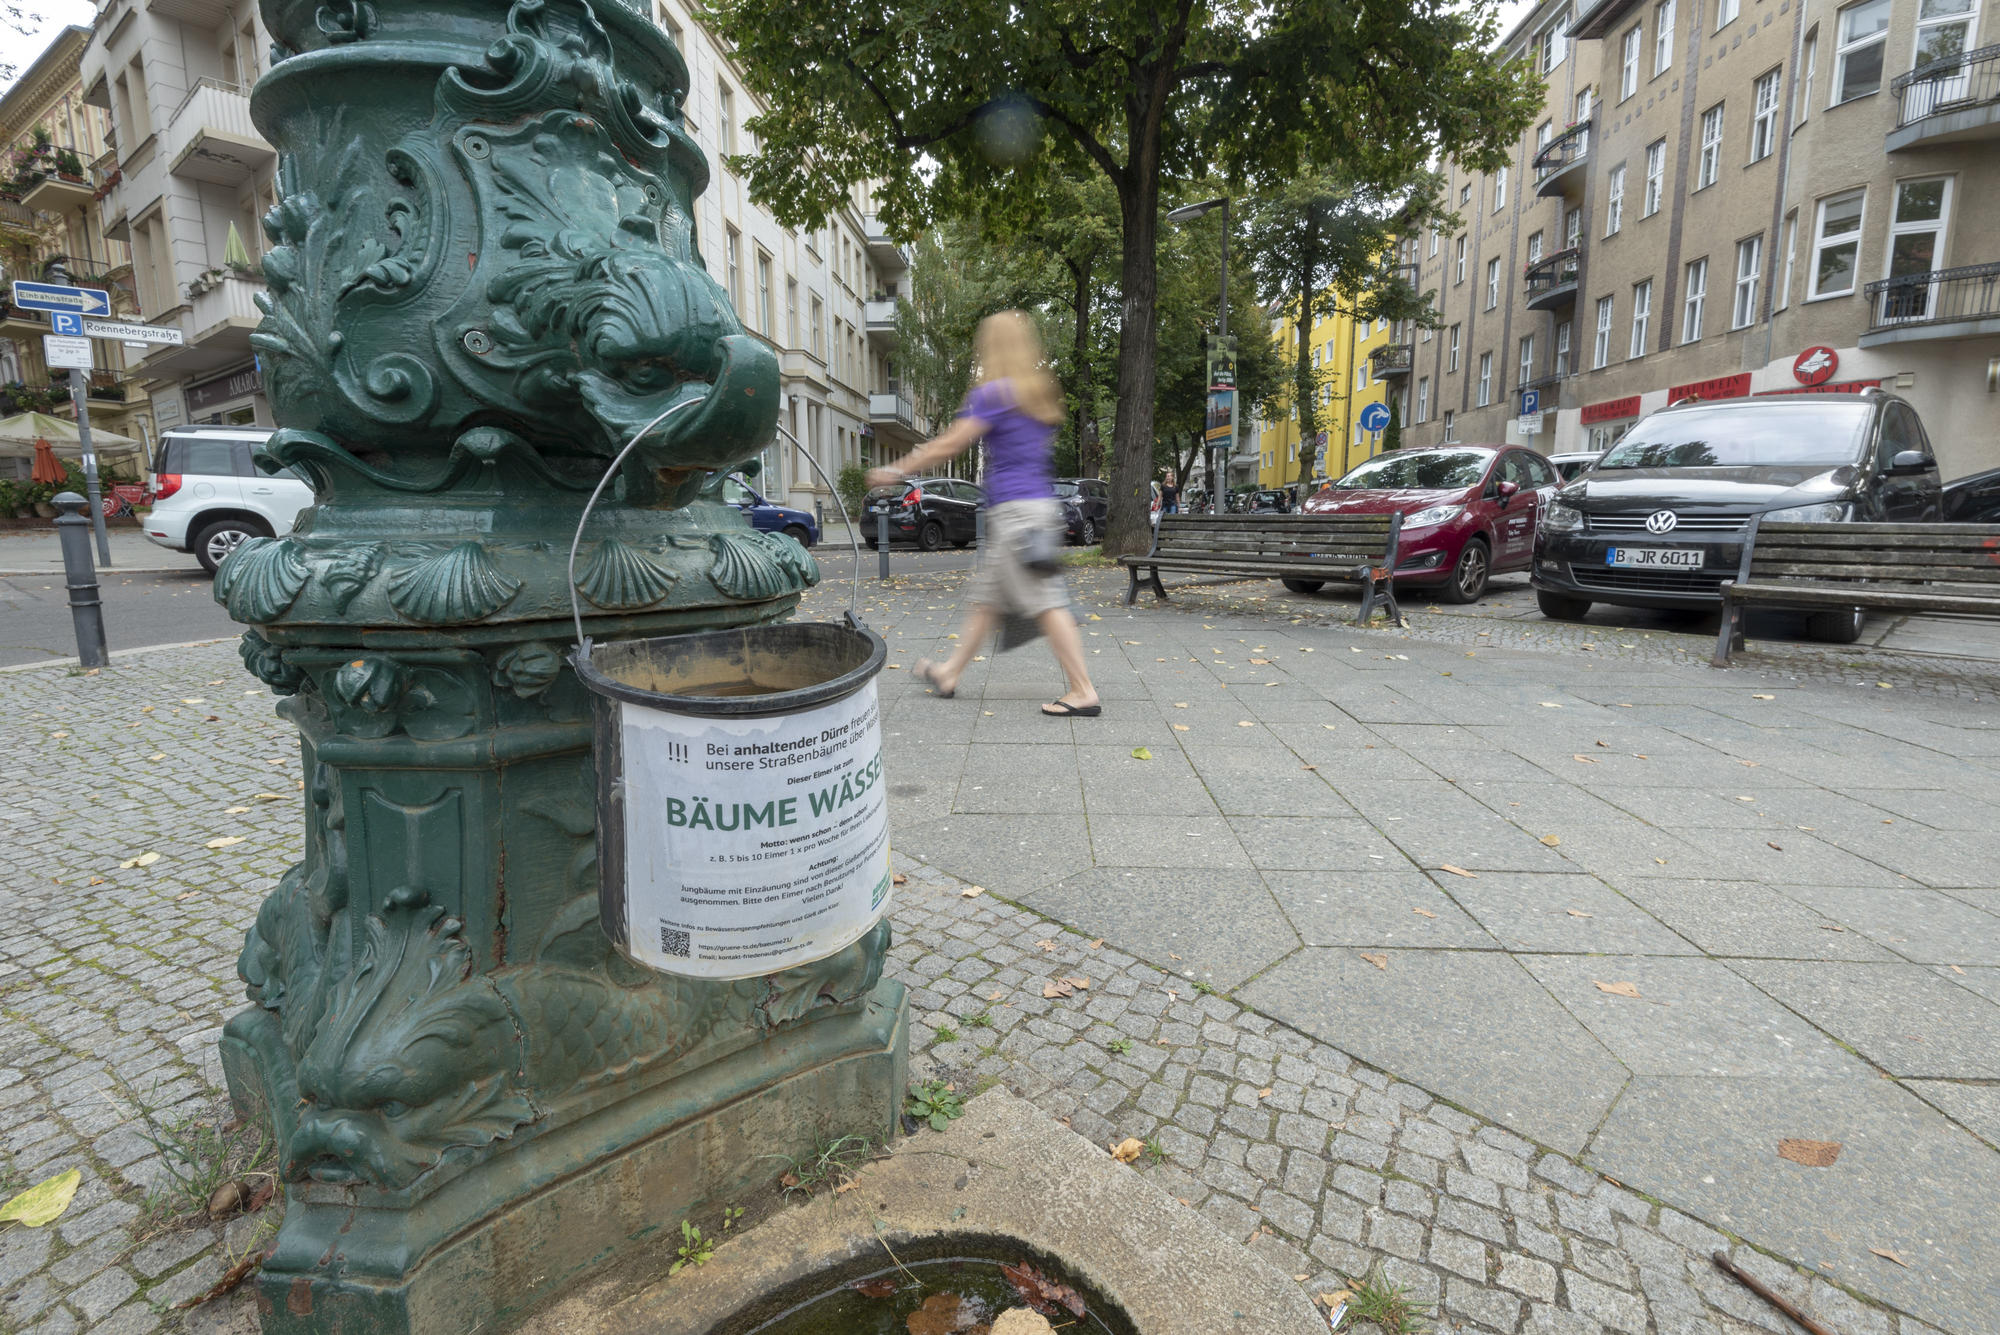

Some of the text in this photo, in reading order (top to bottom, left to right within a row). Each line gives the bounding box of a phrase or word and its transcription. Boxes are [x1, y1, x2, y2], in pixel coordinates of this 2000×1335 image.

[20, 291, 84, 304] Einbahnstraße
[57, 315, 73, 332] P
[86, 321, 178, 341] Roennebergstraße
[1525, 394, 1535, 413] P
[1616, 550, 1701, 566] B JR 6011
[706, 743, 729, 756] Bei
[734, 736, 818, 756] anhaltender
[821, 724, 849, 743] Dürre
[706, 760, 754, 771] unsere
[759, 739, 848, 770] Straßenbäume
[850, 727, 865, 745] über
[668, 741, 688, 764] !!!
[787, 758, 854, 785] Dieser Eimer ist zum
[666, 796, 798, 832] BÄUME
[718, 855, 727, 863] B.
[729, 855, 735, 863] 5
[736, 854, 750, 862] bis
[751, 853, 763, 861] 10
[764, 849, 788, 860] Eimer
[803, 844, 816, 854] pro
[817, 834, 840, 848] Woche
[840, 829, 849, 839] für
[760, 840, 789, 849] Motto:
[789, 834, 811, 844] wenn
[811, 827, 832, 839] schon
[808, 856, 839, 871] Achtung:
[680, 896, 740, 906] ausgenommen.
[742, 897, 762, 905] Bitte
[764, 895, 780, 903] den
[781, 889, 804, 901] Eimer
[805, 883, 823, 894] nach
[823, 866, 855, 887] Benutzung
[681, 884, 726, 895] Jungbäume
[728, 887, 742, 895] mit
[744, 881, 792, 895] Einzäunung
[793, 876, 809, 887] sind
[810, 871, 824, 881] von
[824, 863, 844, 876] dieser
[801, 883, 844, 904] Vielen Dank!
